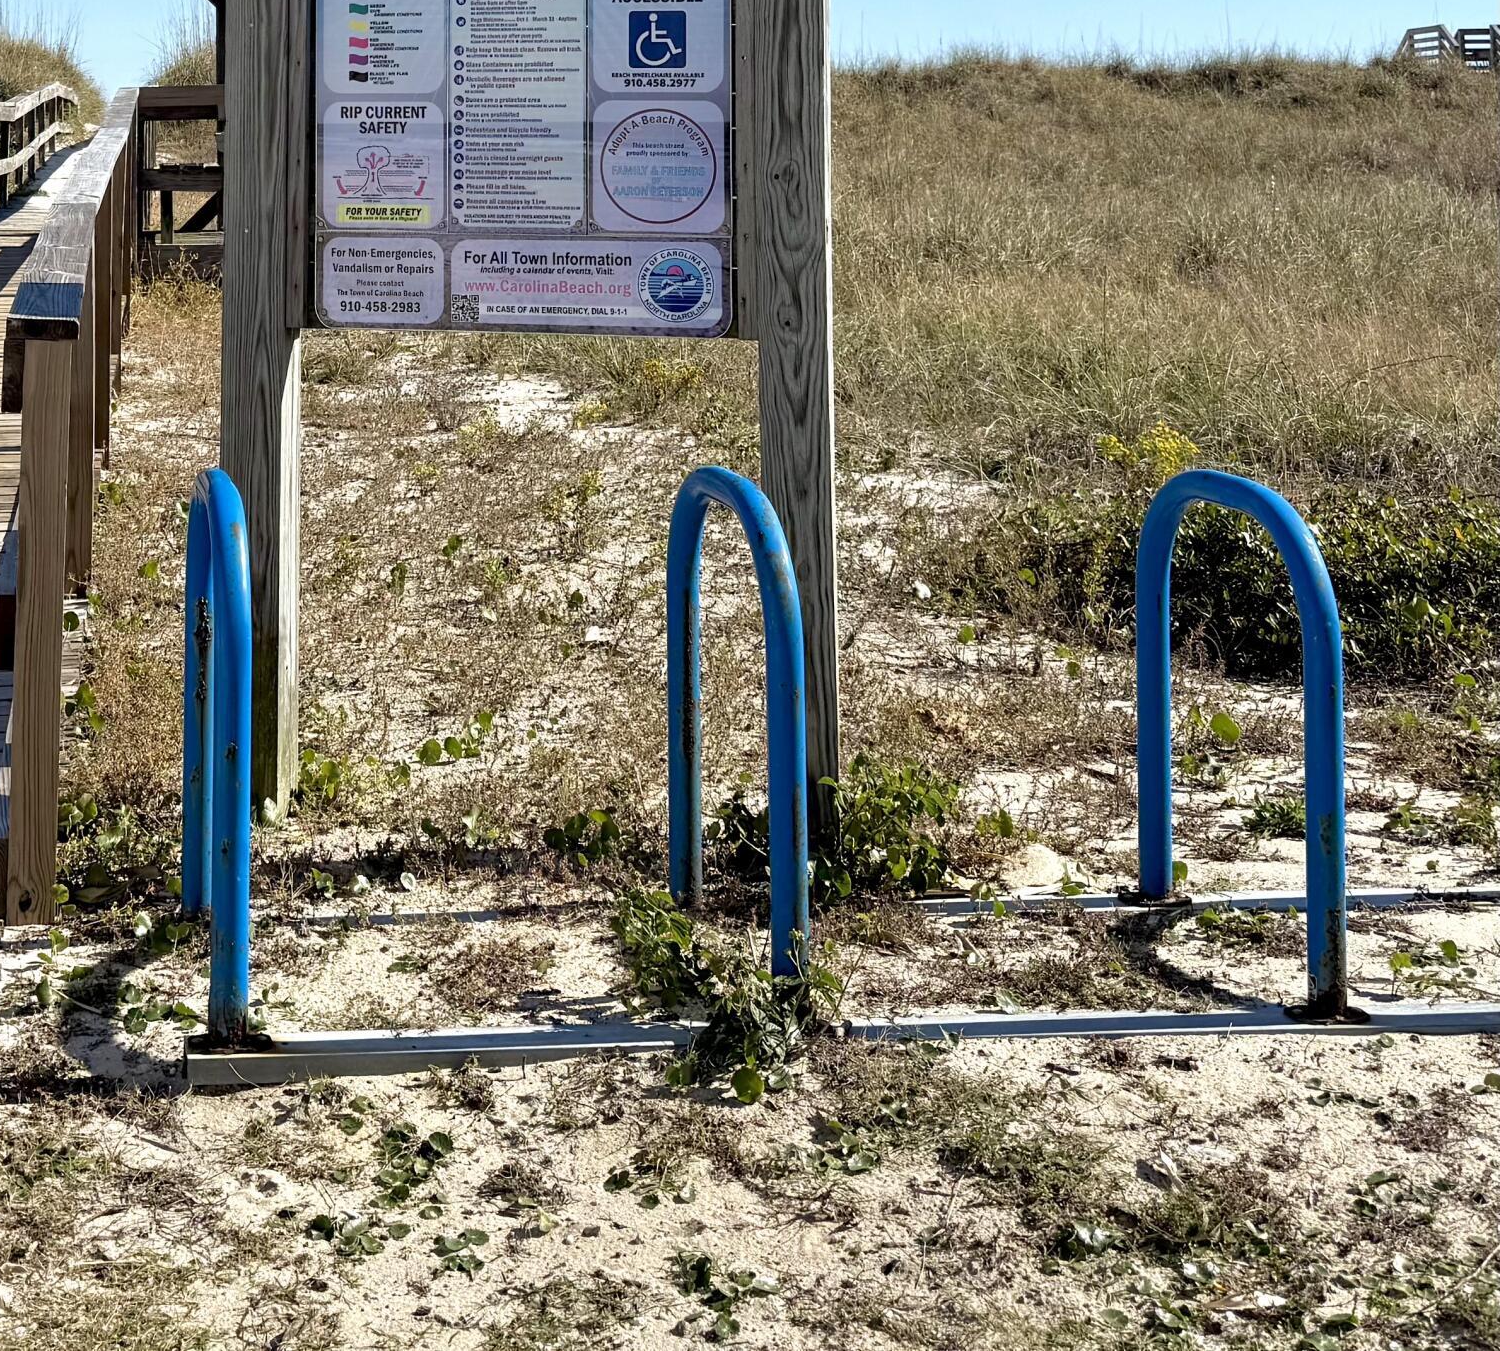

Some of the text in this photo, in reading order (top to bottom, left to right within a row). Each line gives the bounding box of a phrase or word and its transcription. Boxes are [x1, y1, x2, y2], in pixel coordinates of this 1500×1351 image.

[624, 78, 696, 88] 910.458.2977
[340, 106, 428, 119] RIP CURRENT
[359, 121, 408, 134] SAFETY
[608, 115, 710, 157] Adopt-A-Beach Program
[346, 208, 422, 216] FOR YOUR SAFETY
[331, 248, 436, 260] For Non-Emergencies,
[464, 250, 632, 267] For All Town Information
[332, 263, 435, 276] Vandalism or Repairs
[522, 266, 555, 274] calendar
[556, 266, 566, 274] of
[566, 268, 594, 276] events,
[640, 251, 712, 294] TOWN OF CAROLINA BEACH
[464, 280, 632, 297] www.CarolinaBeach.org
[340, 300, 421, 313] 910-458-2983
[496, 306, 516, 314] CASE
[529, 306, 540, 314] AN
[542, 306, 590, 315] EMERGENCY,
[644, 299, 708, 320] NORTH CAROLINA
